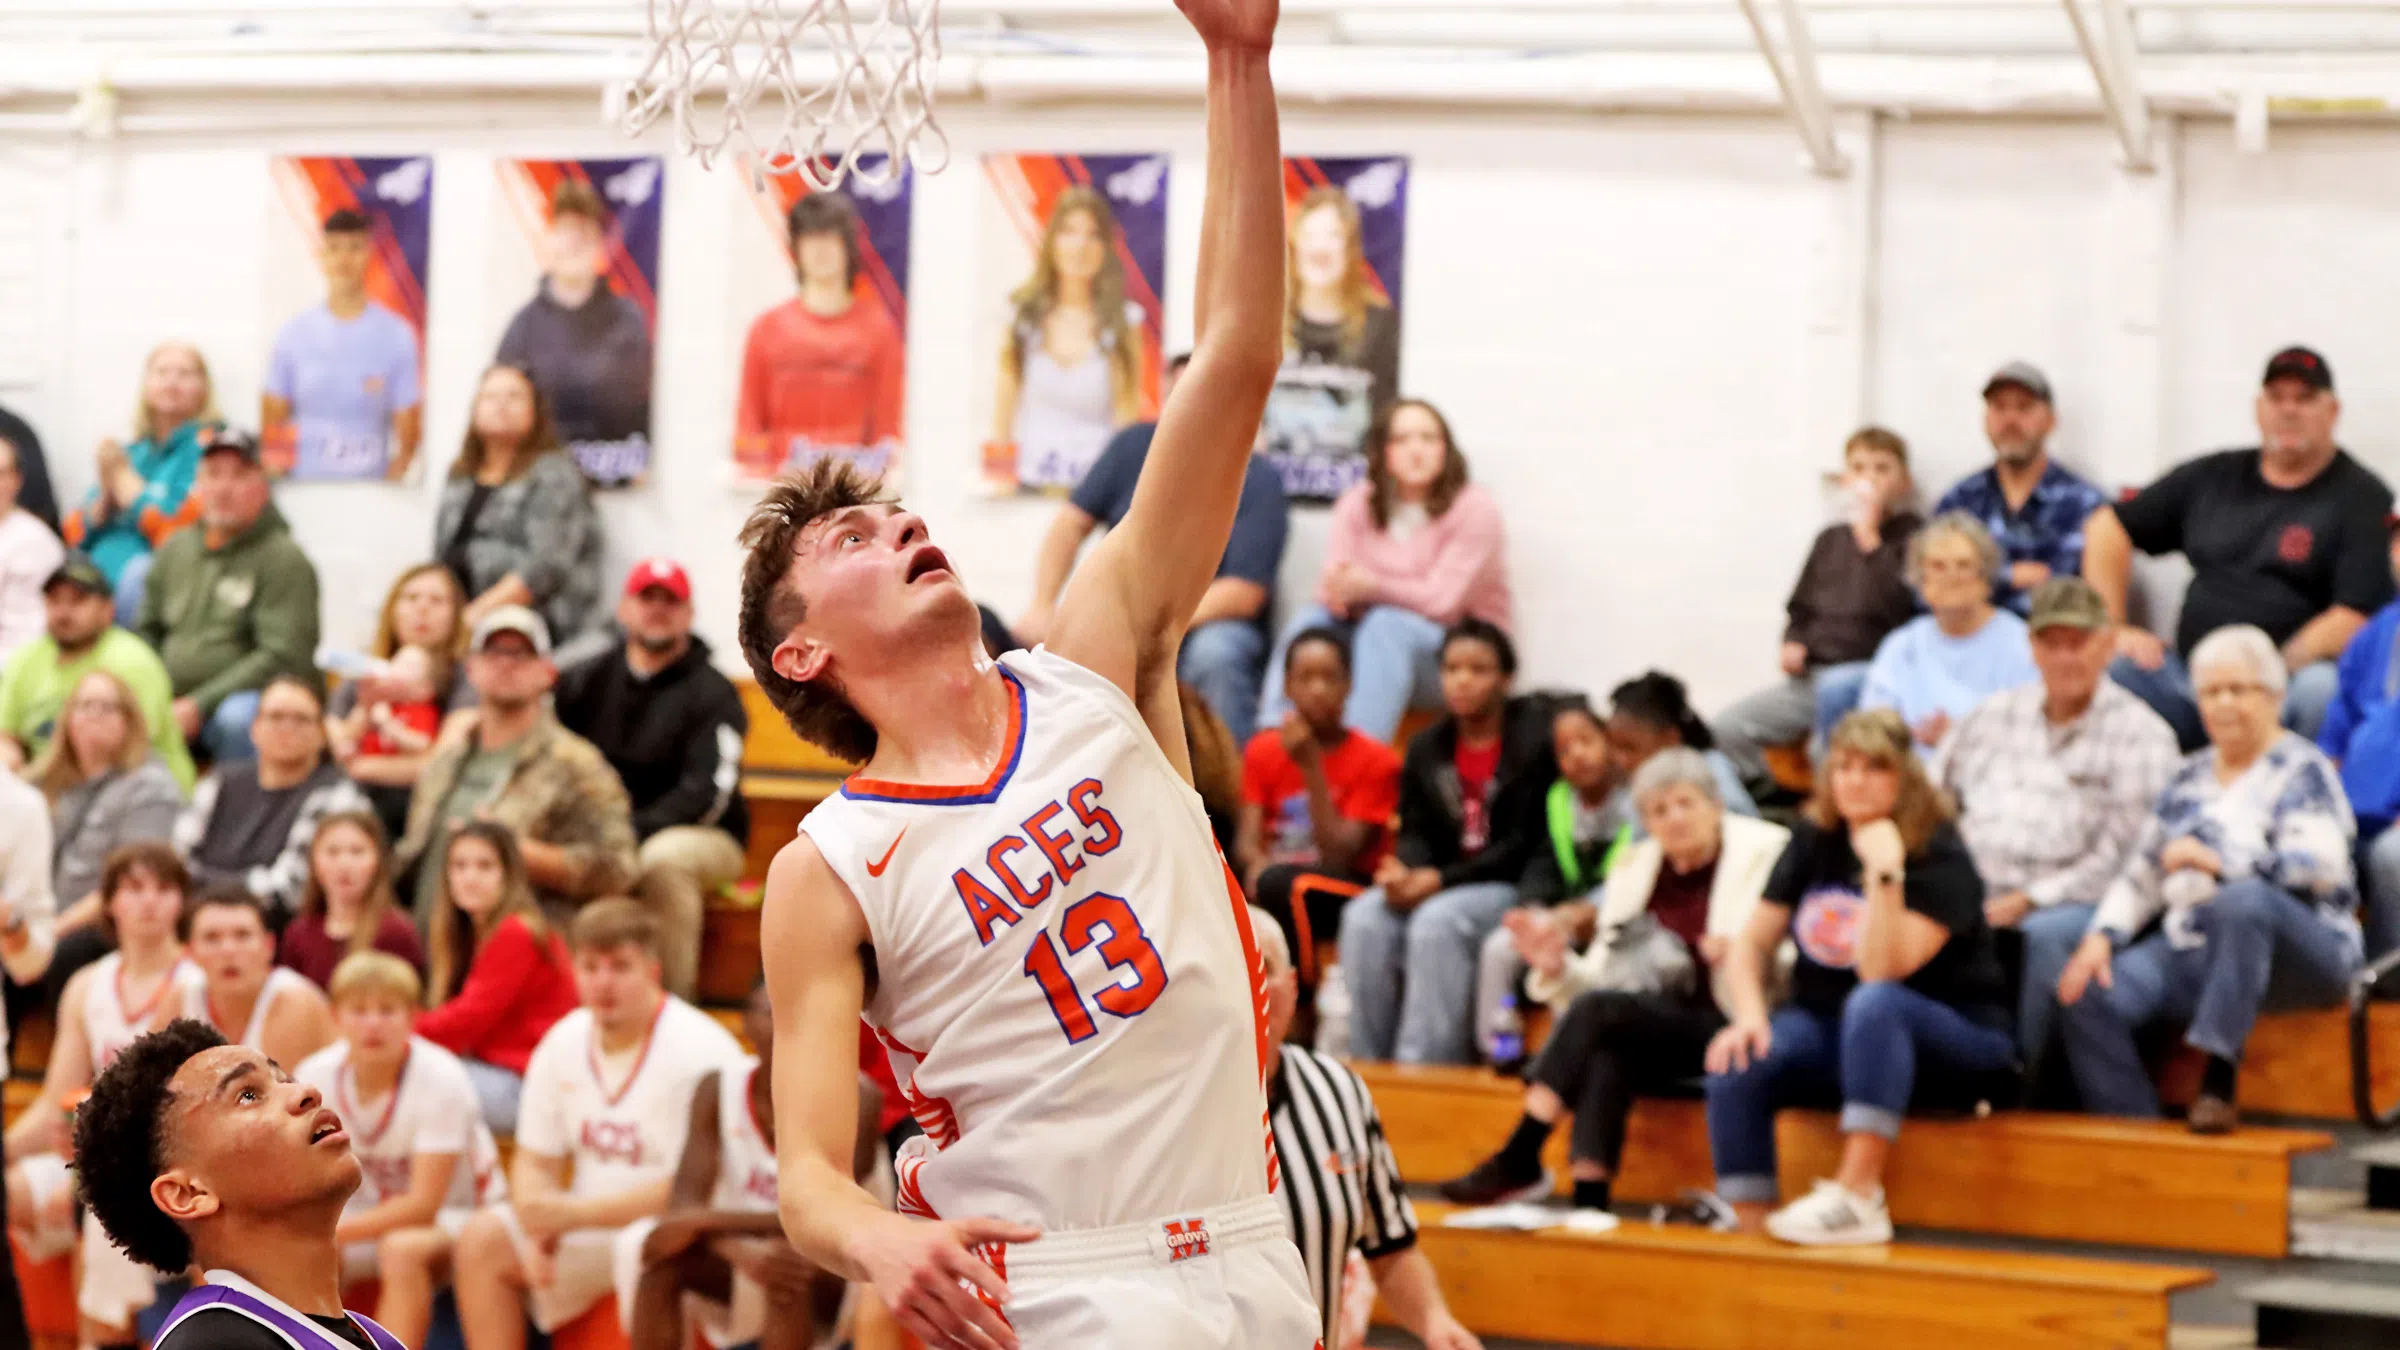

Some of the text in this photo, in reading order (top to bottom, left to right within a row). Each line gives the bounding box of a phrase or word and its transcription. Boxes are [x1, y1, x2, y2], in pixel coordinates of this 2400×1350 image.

[952, 778, 1123, 947] ACES
[1024, 891, 1169, 1045] 13
[1163, 1217, 1210, 1262] M
[1167, 1230, 1209, 1248] GROVE
